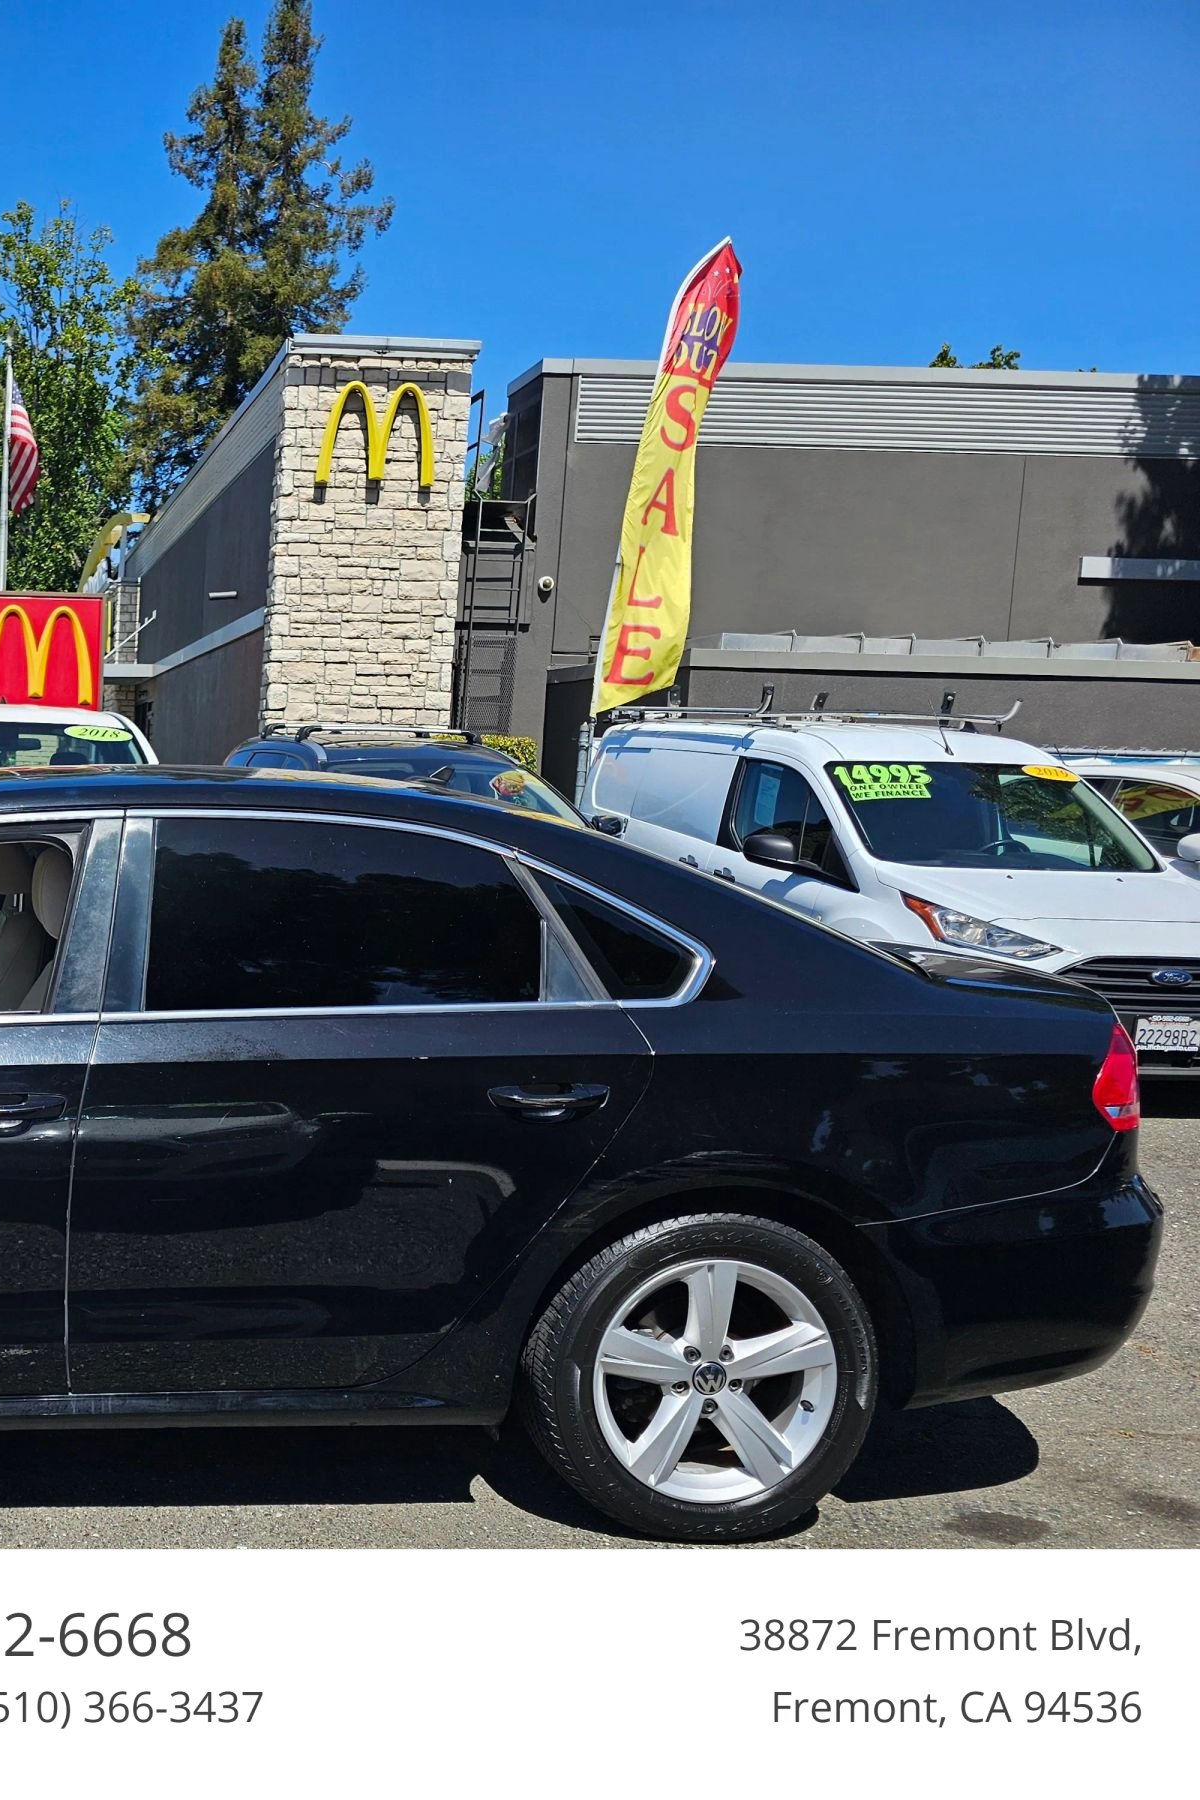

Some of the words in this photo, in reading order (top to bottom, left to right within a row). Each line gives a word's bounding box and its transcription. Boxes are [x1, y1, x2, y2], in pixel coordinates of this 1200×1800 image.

[603, 384, 697, 686] SALE
[78, 727, 121, 740] 2018
[833, 764, 933, 786] 14995
[852, 791, 871, 799] WE
[874, 790, 927, 798] FINANCE
[1137, 1028, 1198, 1047] 22298R2
